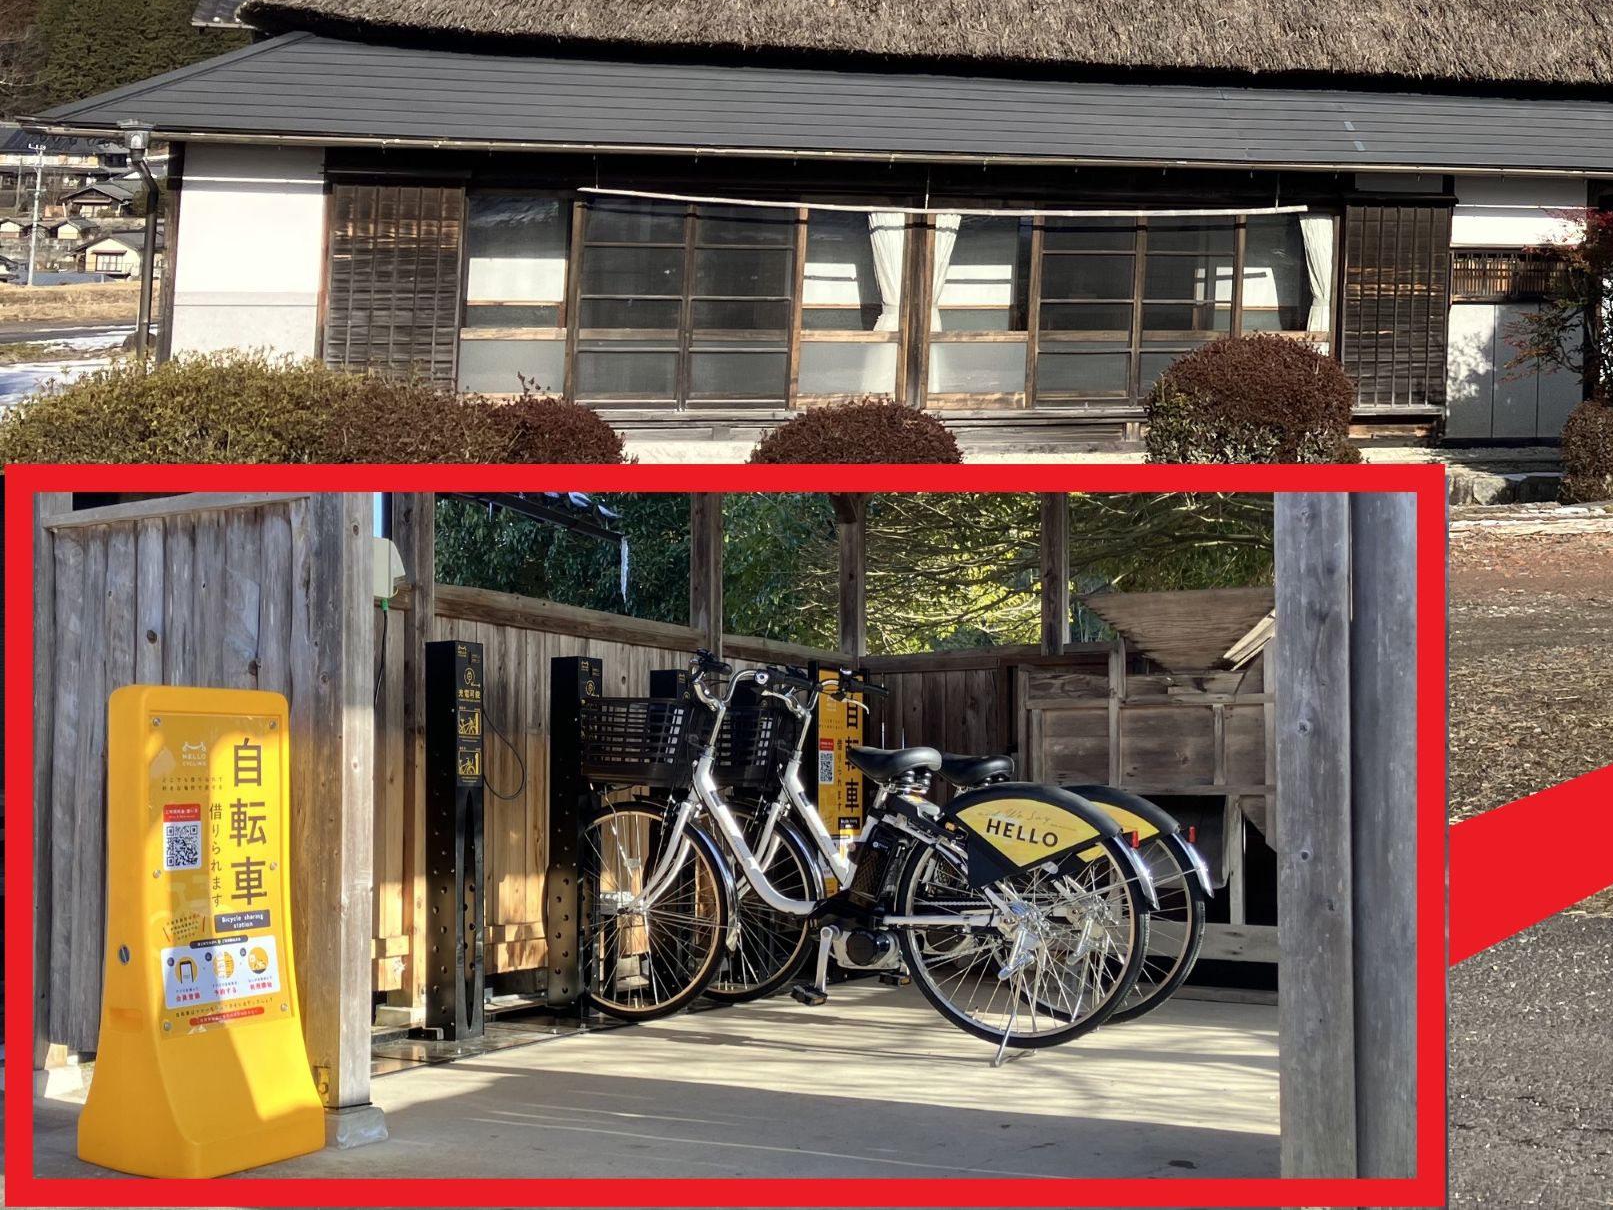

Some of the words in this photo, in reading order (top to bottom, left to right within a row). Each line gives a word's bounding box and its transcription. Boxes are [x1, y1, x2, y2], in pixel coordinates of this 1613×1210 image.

[229, 737, 268, 906] 自転車
[986, 817, 1059, 848] HELLO
[209, 802, 223, 908] 借りられます
[221, 914, 242, 924] Bicycle
[244, 912, 264, 921] sharing
[233, 921, 253, 929] station
